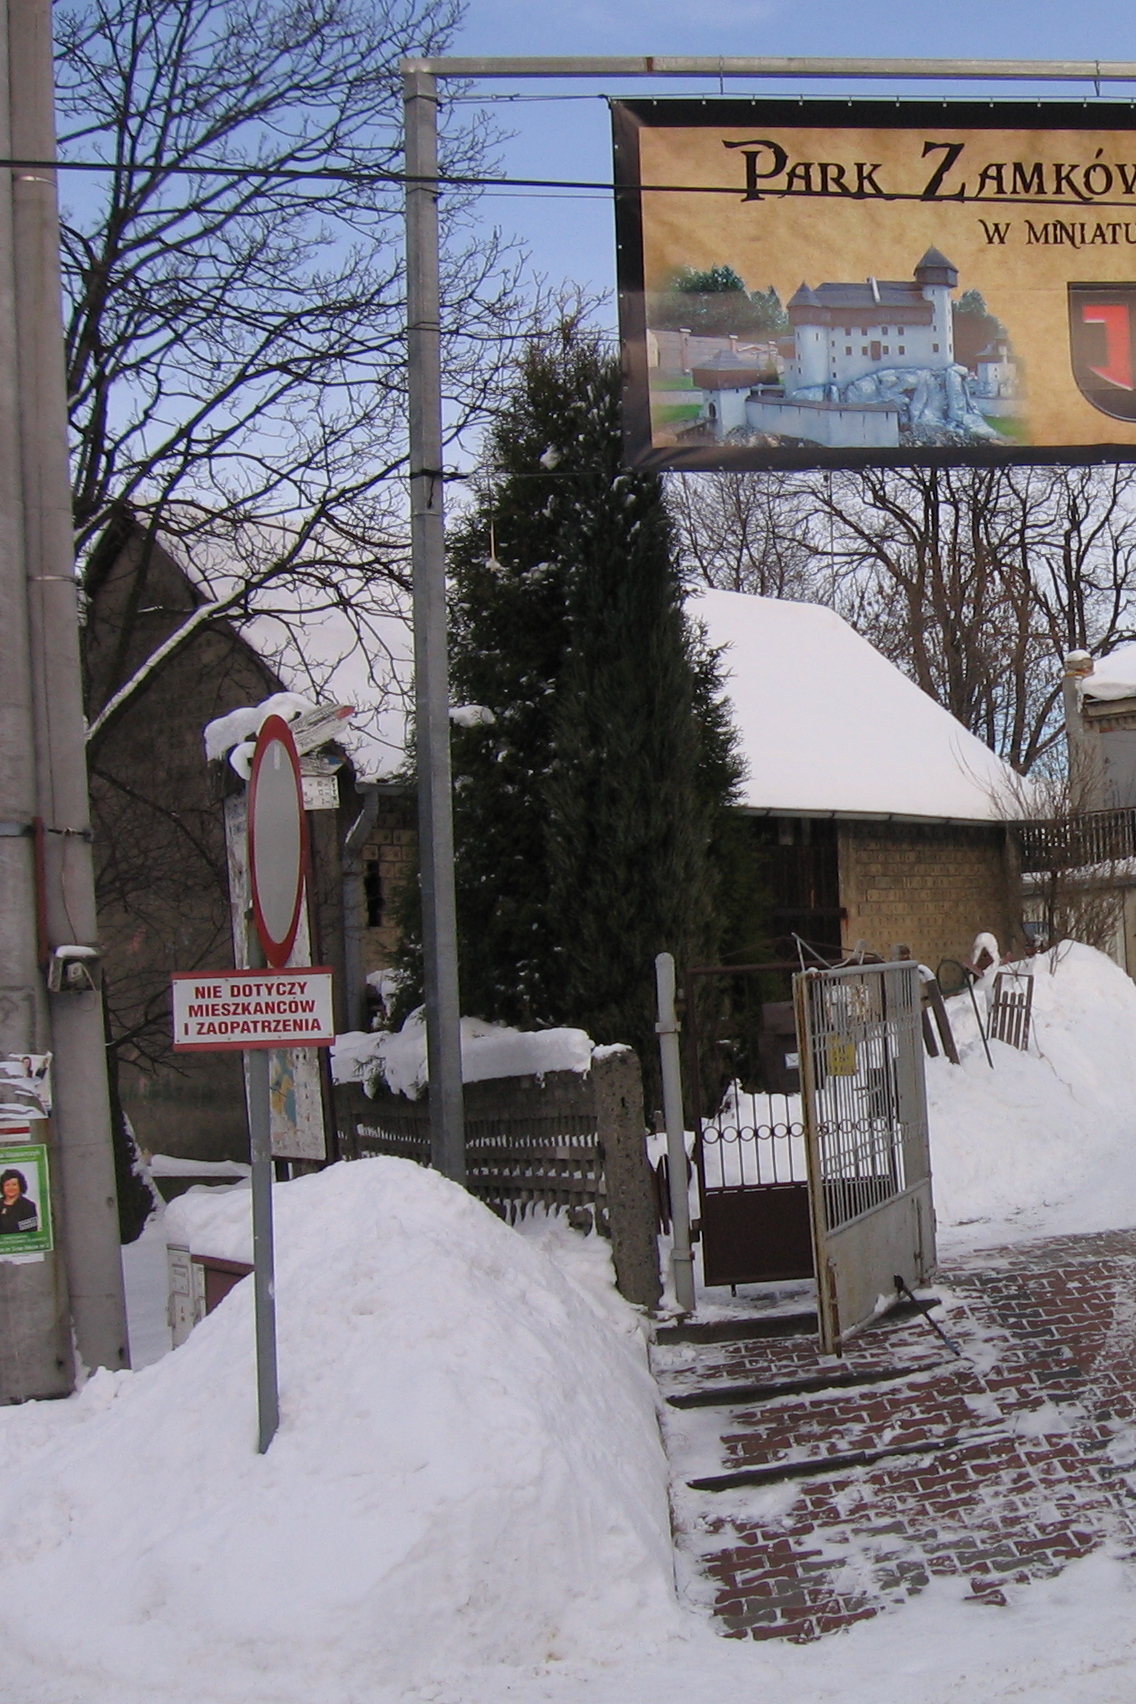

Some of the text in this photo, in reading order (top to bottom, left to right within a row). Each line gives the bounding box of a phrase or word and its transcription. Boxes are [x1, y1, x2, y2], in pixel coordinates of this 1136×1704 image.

[195, 981, 307, 999] NIE DOTYCZY
[184, 1018, 322, 1036] I ZAOPATRZENIA
